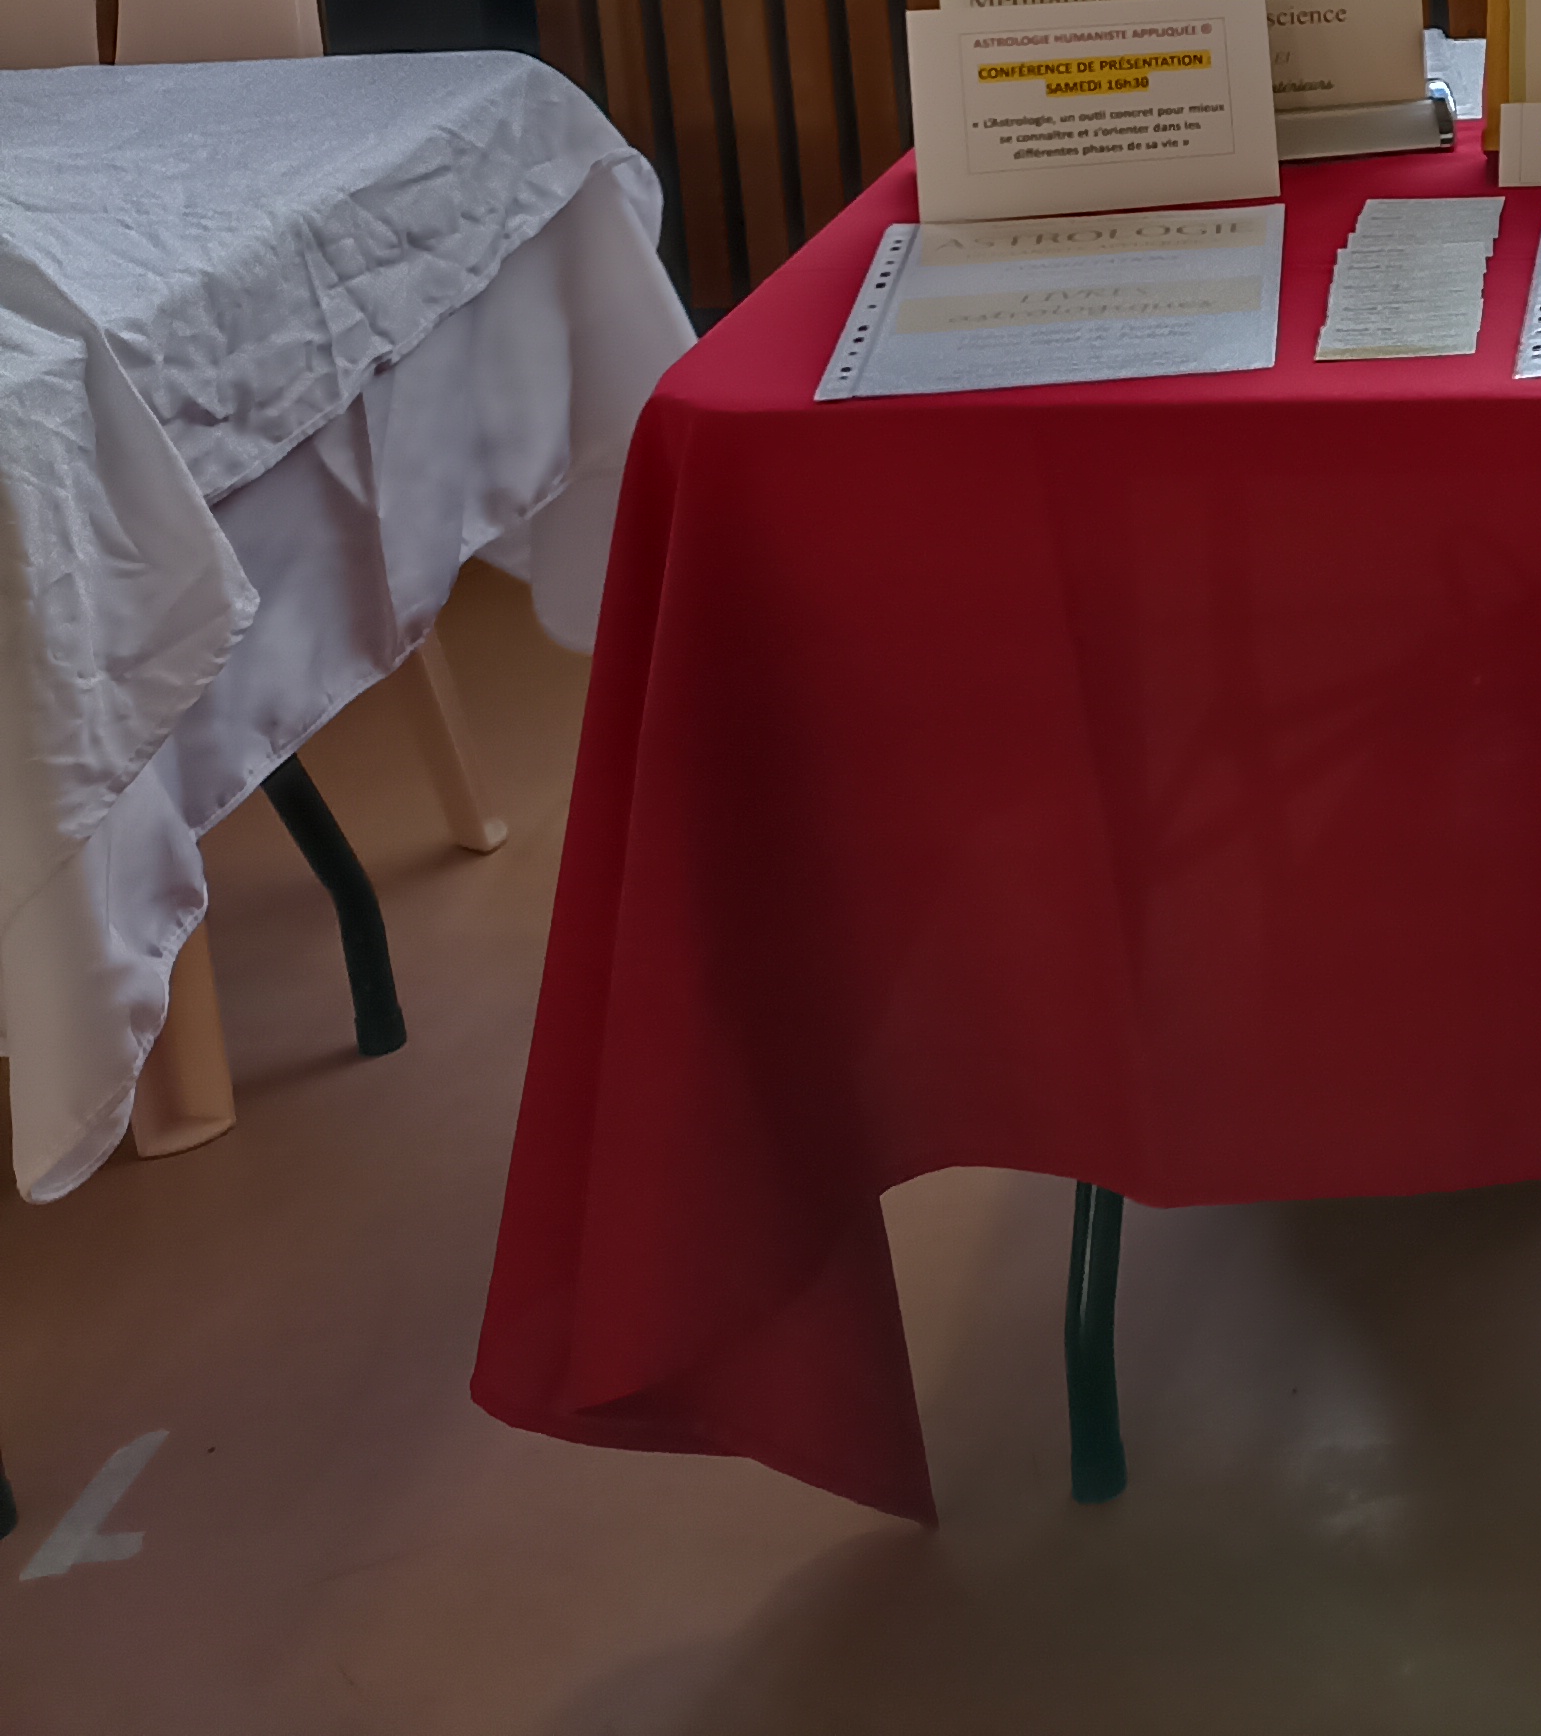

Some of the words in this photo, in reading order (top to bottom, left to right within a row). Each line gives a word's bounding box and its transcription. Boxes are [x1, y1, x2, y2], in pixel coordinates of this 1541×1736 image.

[978, 62, 1072, 80] CONFÉRENCE
[1077, 62, 1095, 73] DE
[1100, 54, 1203, 71] PRÉSENTATION
[1046, 80, 1102, 95] SAMEDI
[1107, 76, 1149, 90] 16h30
